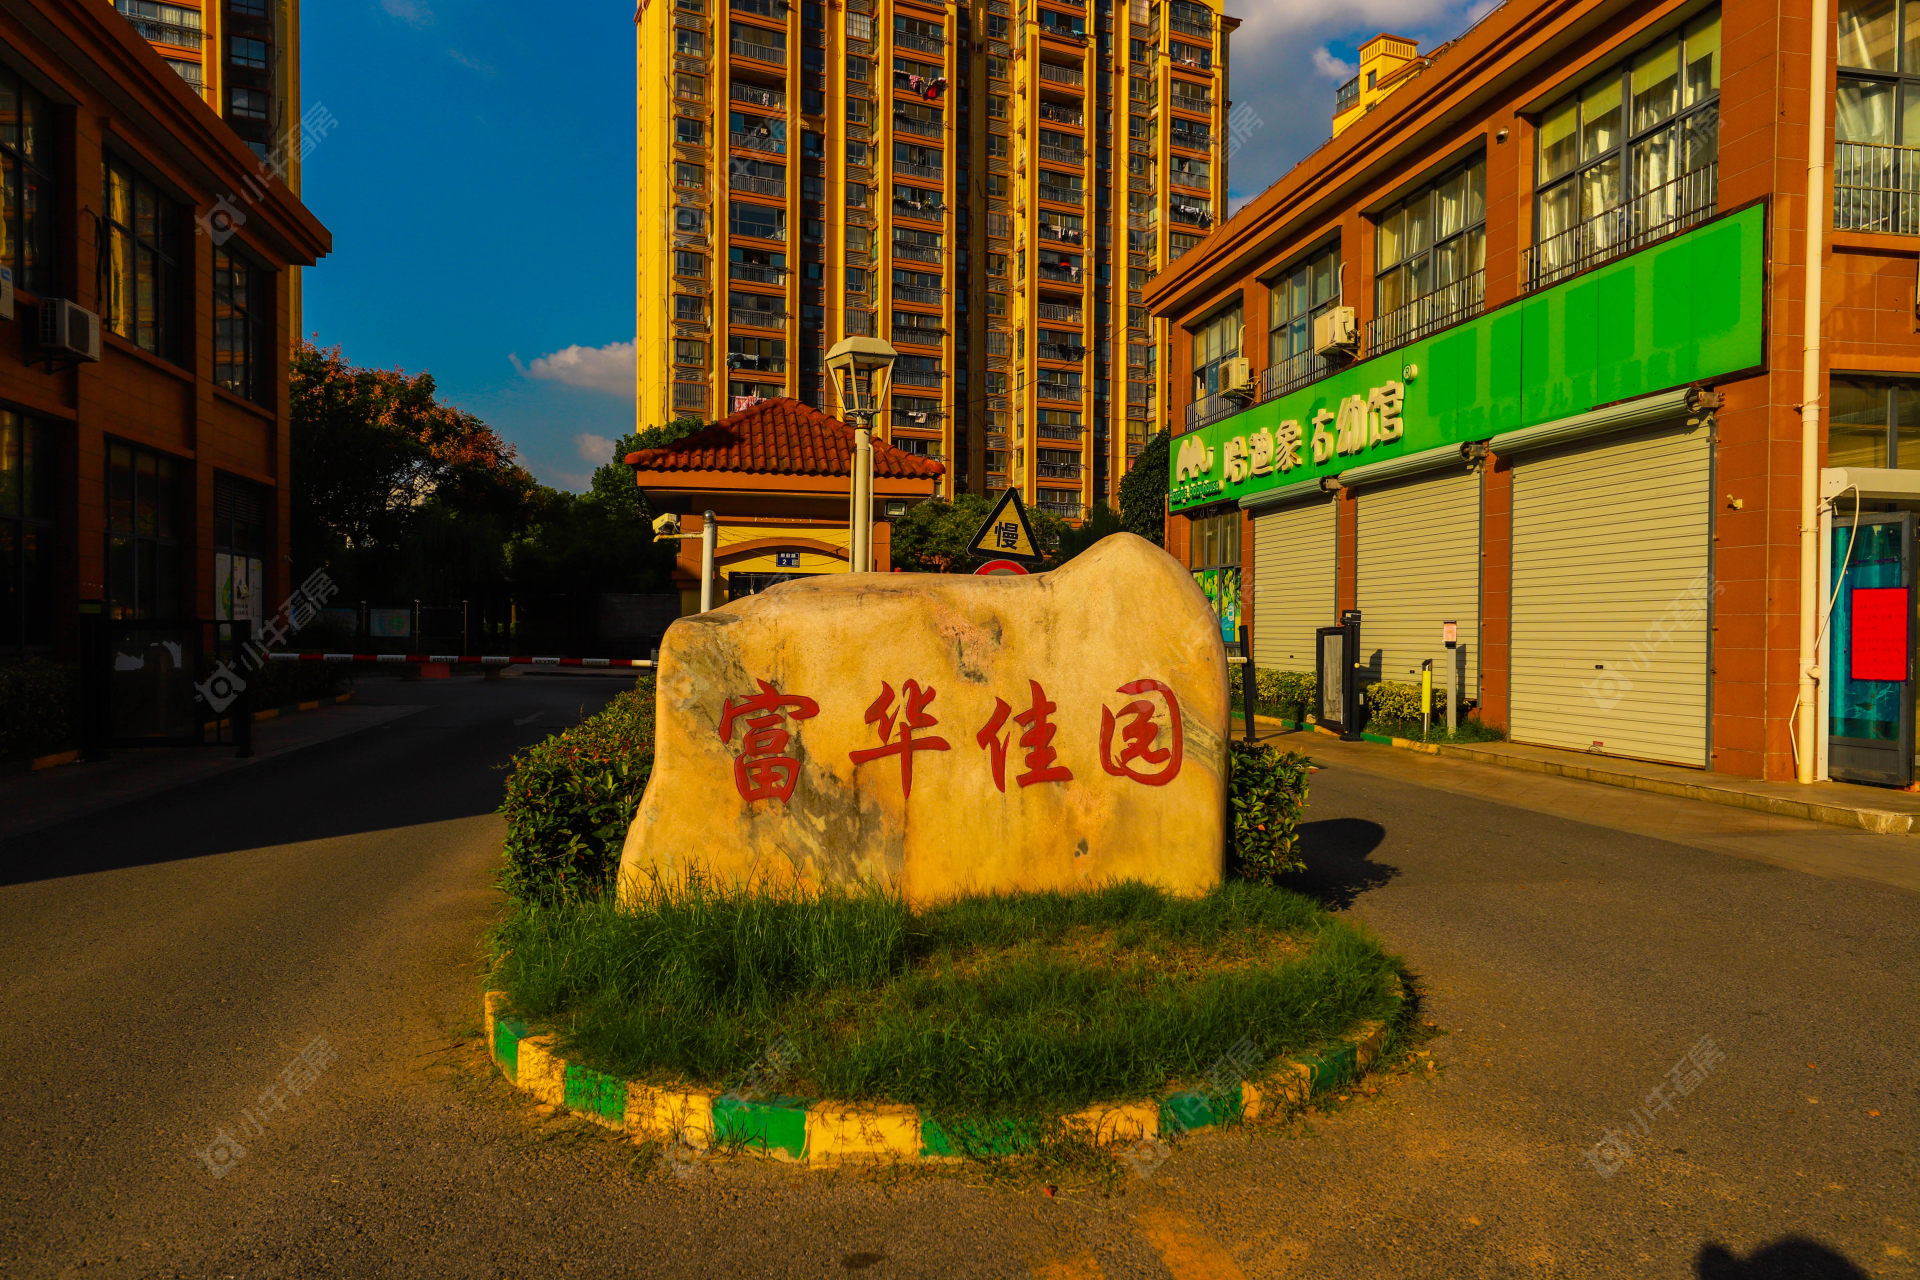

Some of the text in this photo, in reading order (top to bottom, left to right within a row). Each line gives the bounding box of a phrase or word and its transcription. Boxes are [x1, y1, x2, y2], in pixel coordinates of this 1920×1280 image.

[994, 521, 1019, 550] 慢
[718, 678, 1184, 804] 富华佳园
